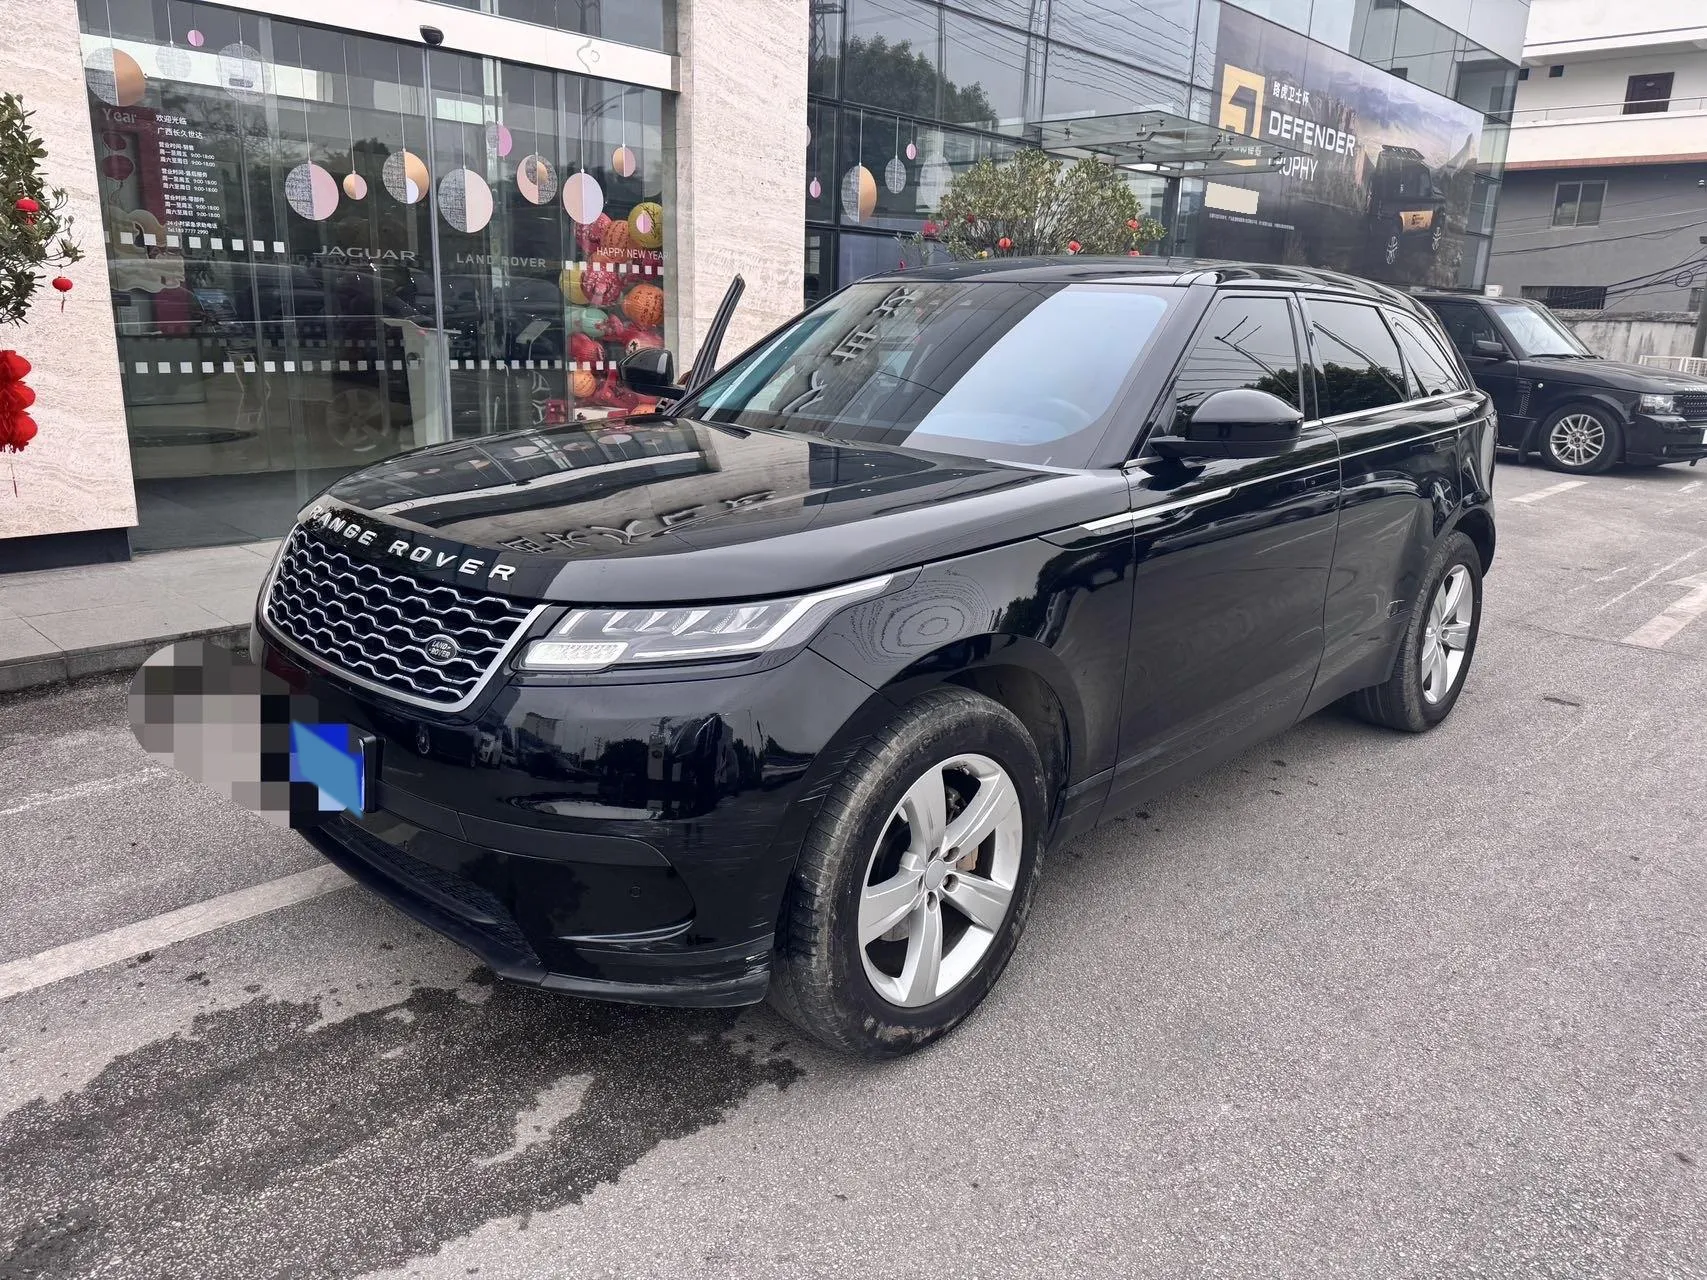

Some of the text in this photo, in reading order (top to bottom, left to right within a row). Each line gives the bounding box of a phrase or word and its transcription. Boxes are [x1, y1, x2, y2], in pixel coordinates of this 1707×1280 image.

[1273, 80, 1311, 106] 路虎卫士杯
[102, 108, 137, 124] Year
[155, 114, 187, 125] 欢迎光临
[157, 127, 203, 140] 广西长久世达
[1268, 110, 1356, 157] DEFENDER
[312, 245, 416, 261] JAGUAR
[456, 252, 546, 268] LAND ROVER
[596, 247, 625, 258] HAPPY
[626, 248, 646, 260] NEW
[310, 505, 516, 581] RANGE ROVER
[430, 647, 450, 659] ROVER
[432, 640, 451, 650] LAND
